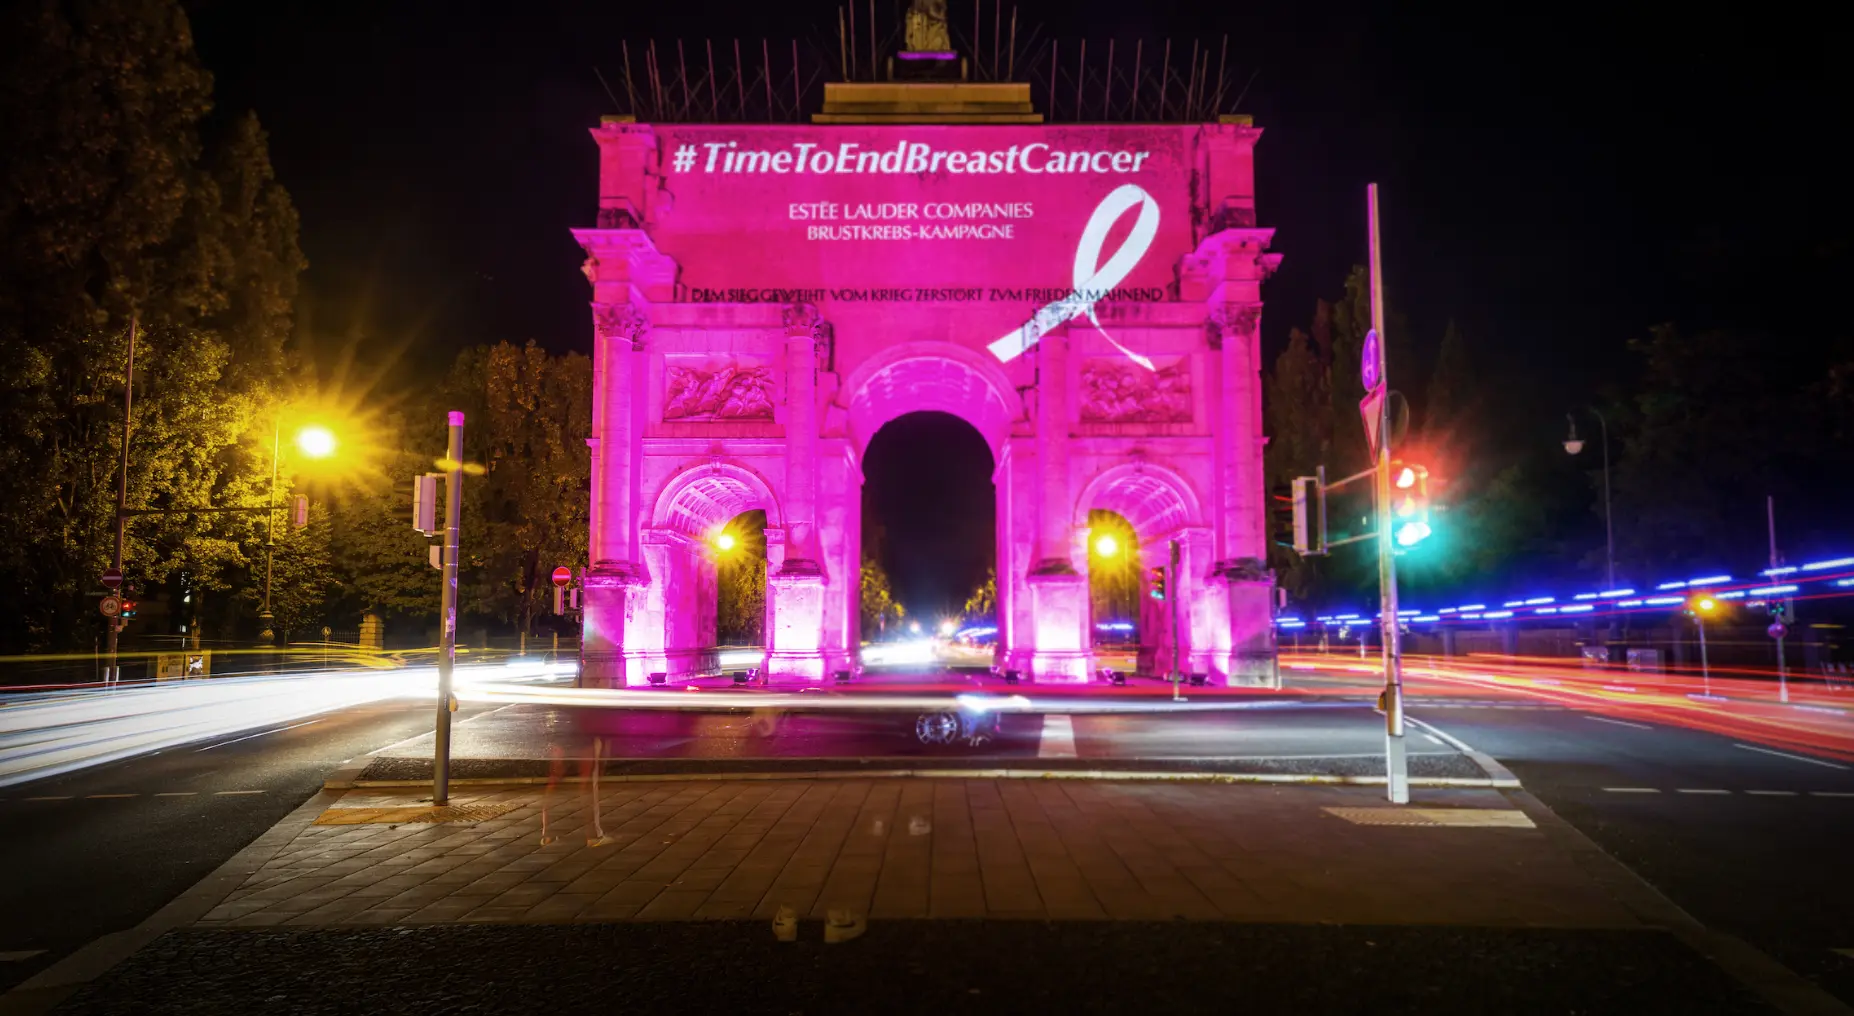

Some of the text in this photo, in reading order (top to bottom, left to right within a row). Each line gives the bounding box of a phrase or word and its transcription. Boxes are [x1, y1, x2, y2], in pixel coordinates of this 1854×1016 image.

[672, 140, 1150, 174] #TimeToEndBreastCancer
[843, 203, 919, 220] LAUDER
[922, 202, 1034, 219] COMPANIES
[806, 223, 1015, 241] BRUSTKREBS-KAMPAGNE
[692, 288, 724, 302] DEM
[728, 288, 758, 302] SIEG
[760, 288, 826, 302] GEWEIHT
[830, 288, 867, 302] VOM
[871, 288, 912, 302] KRIEG
[1025, 288, 1083, 302] FRIEDEN
[1085, 288, 1163, 302] MAHNEND
